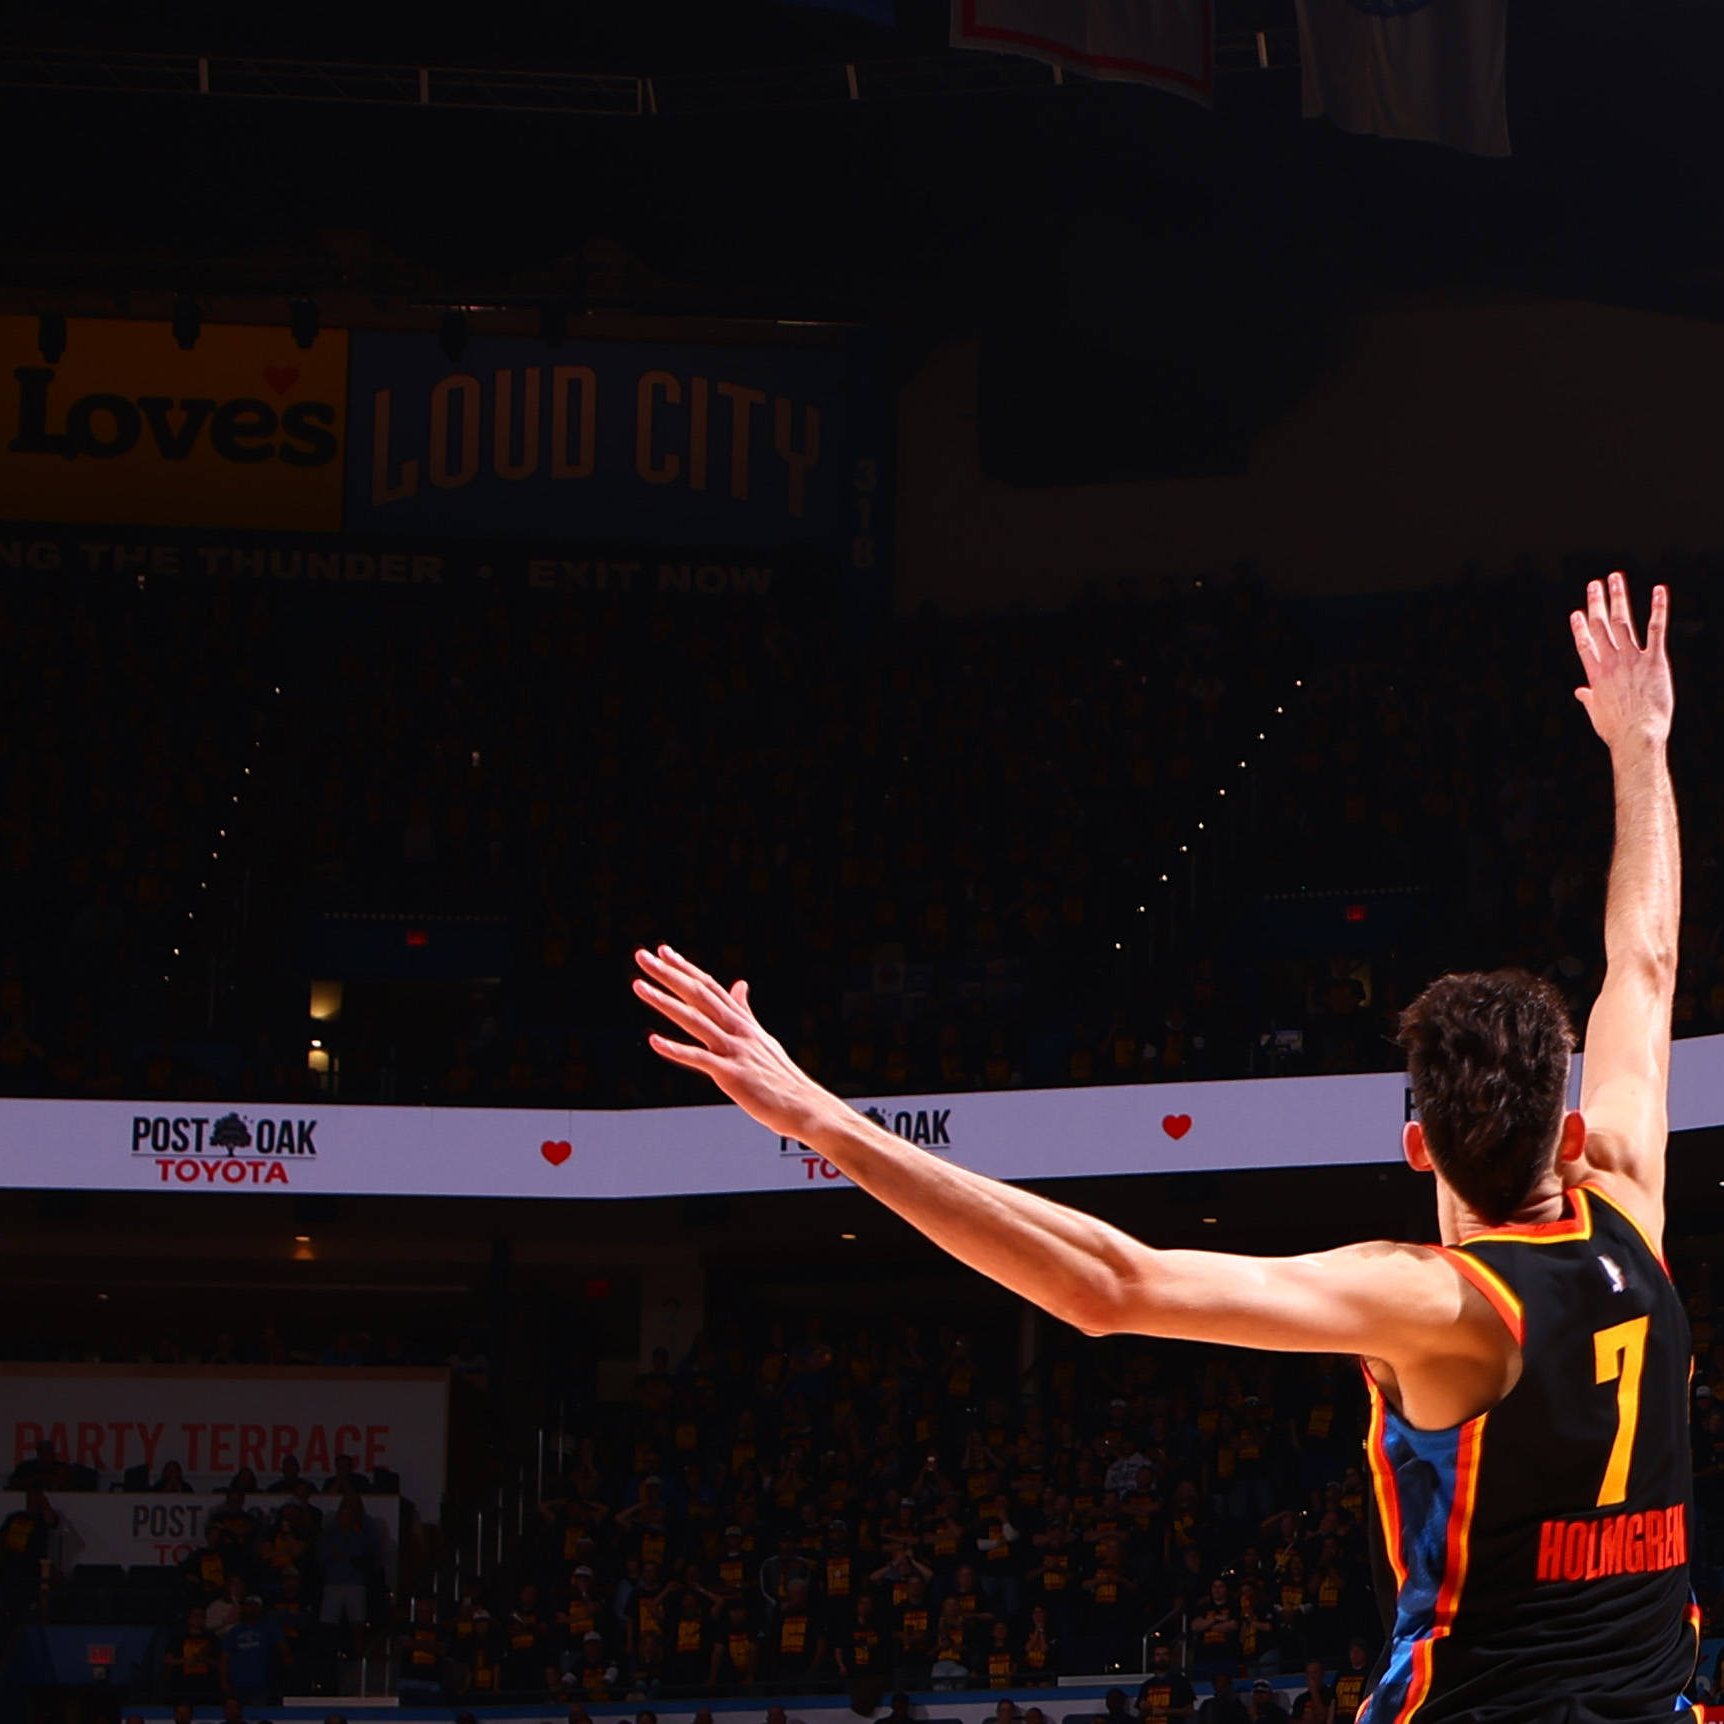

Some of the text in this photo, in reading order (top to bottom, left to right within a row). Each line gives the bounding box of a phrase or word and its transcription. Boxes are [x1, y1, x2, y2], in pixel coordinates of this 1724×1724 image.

[373, 364, 823, 519] LOUD CITY
[197, 546, 445, 586] THUNDER
[528, 559, 643, 592] EXIT
[656, 562, 774, 596] NOW
[132, 1116, 317, 1156] POST OAK
[154, 1159, 289, 1184] TOYOTA
[1593, 1315, 1650, 1508] 7
[14, 1421, 165, 1473] PARTY
[180, 1421, 389, 1475] TERRACE
[132, 1504, 203, 1538] POST
[1536, 1504, 1689, 1582] HOLMGREN
